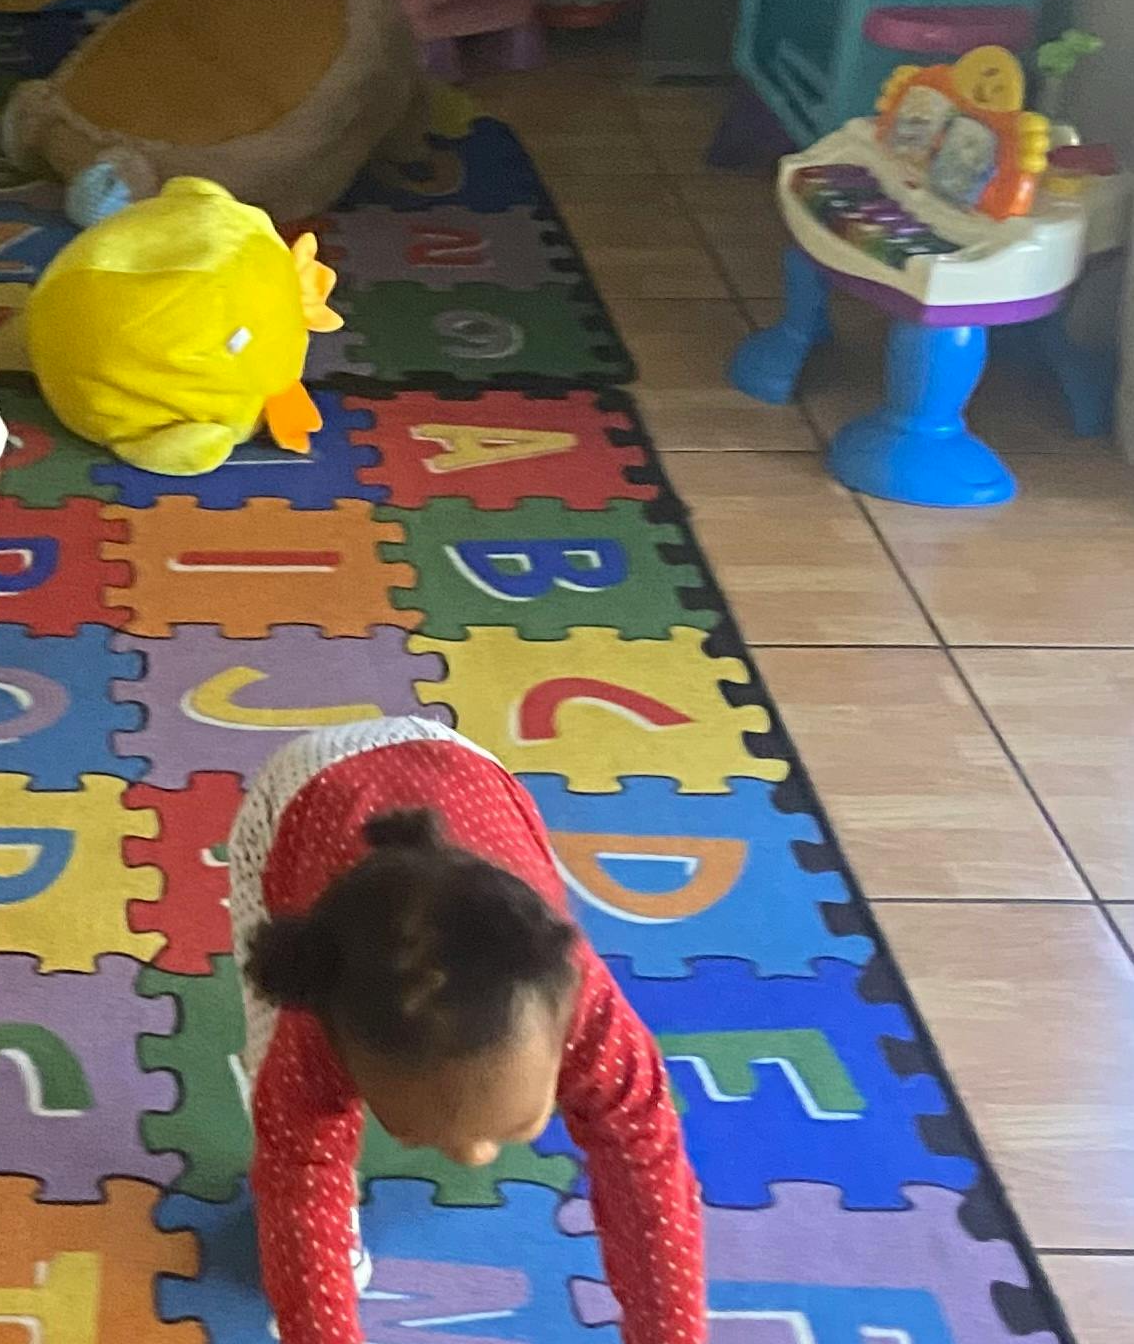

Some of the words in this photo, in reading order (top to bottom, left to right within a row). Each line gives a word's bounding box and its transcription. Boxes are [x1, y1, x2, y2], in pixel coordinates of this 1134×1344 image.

[404, 224, 495, 268] 2
[409, 423, 579, 475] A
[443, 538, 629, 602] B
[181, 664, 385, 730] J
[511, 676, 695, 746] C
[550, 832, 749, 925] D
